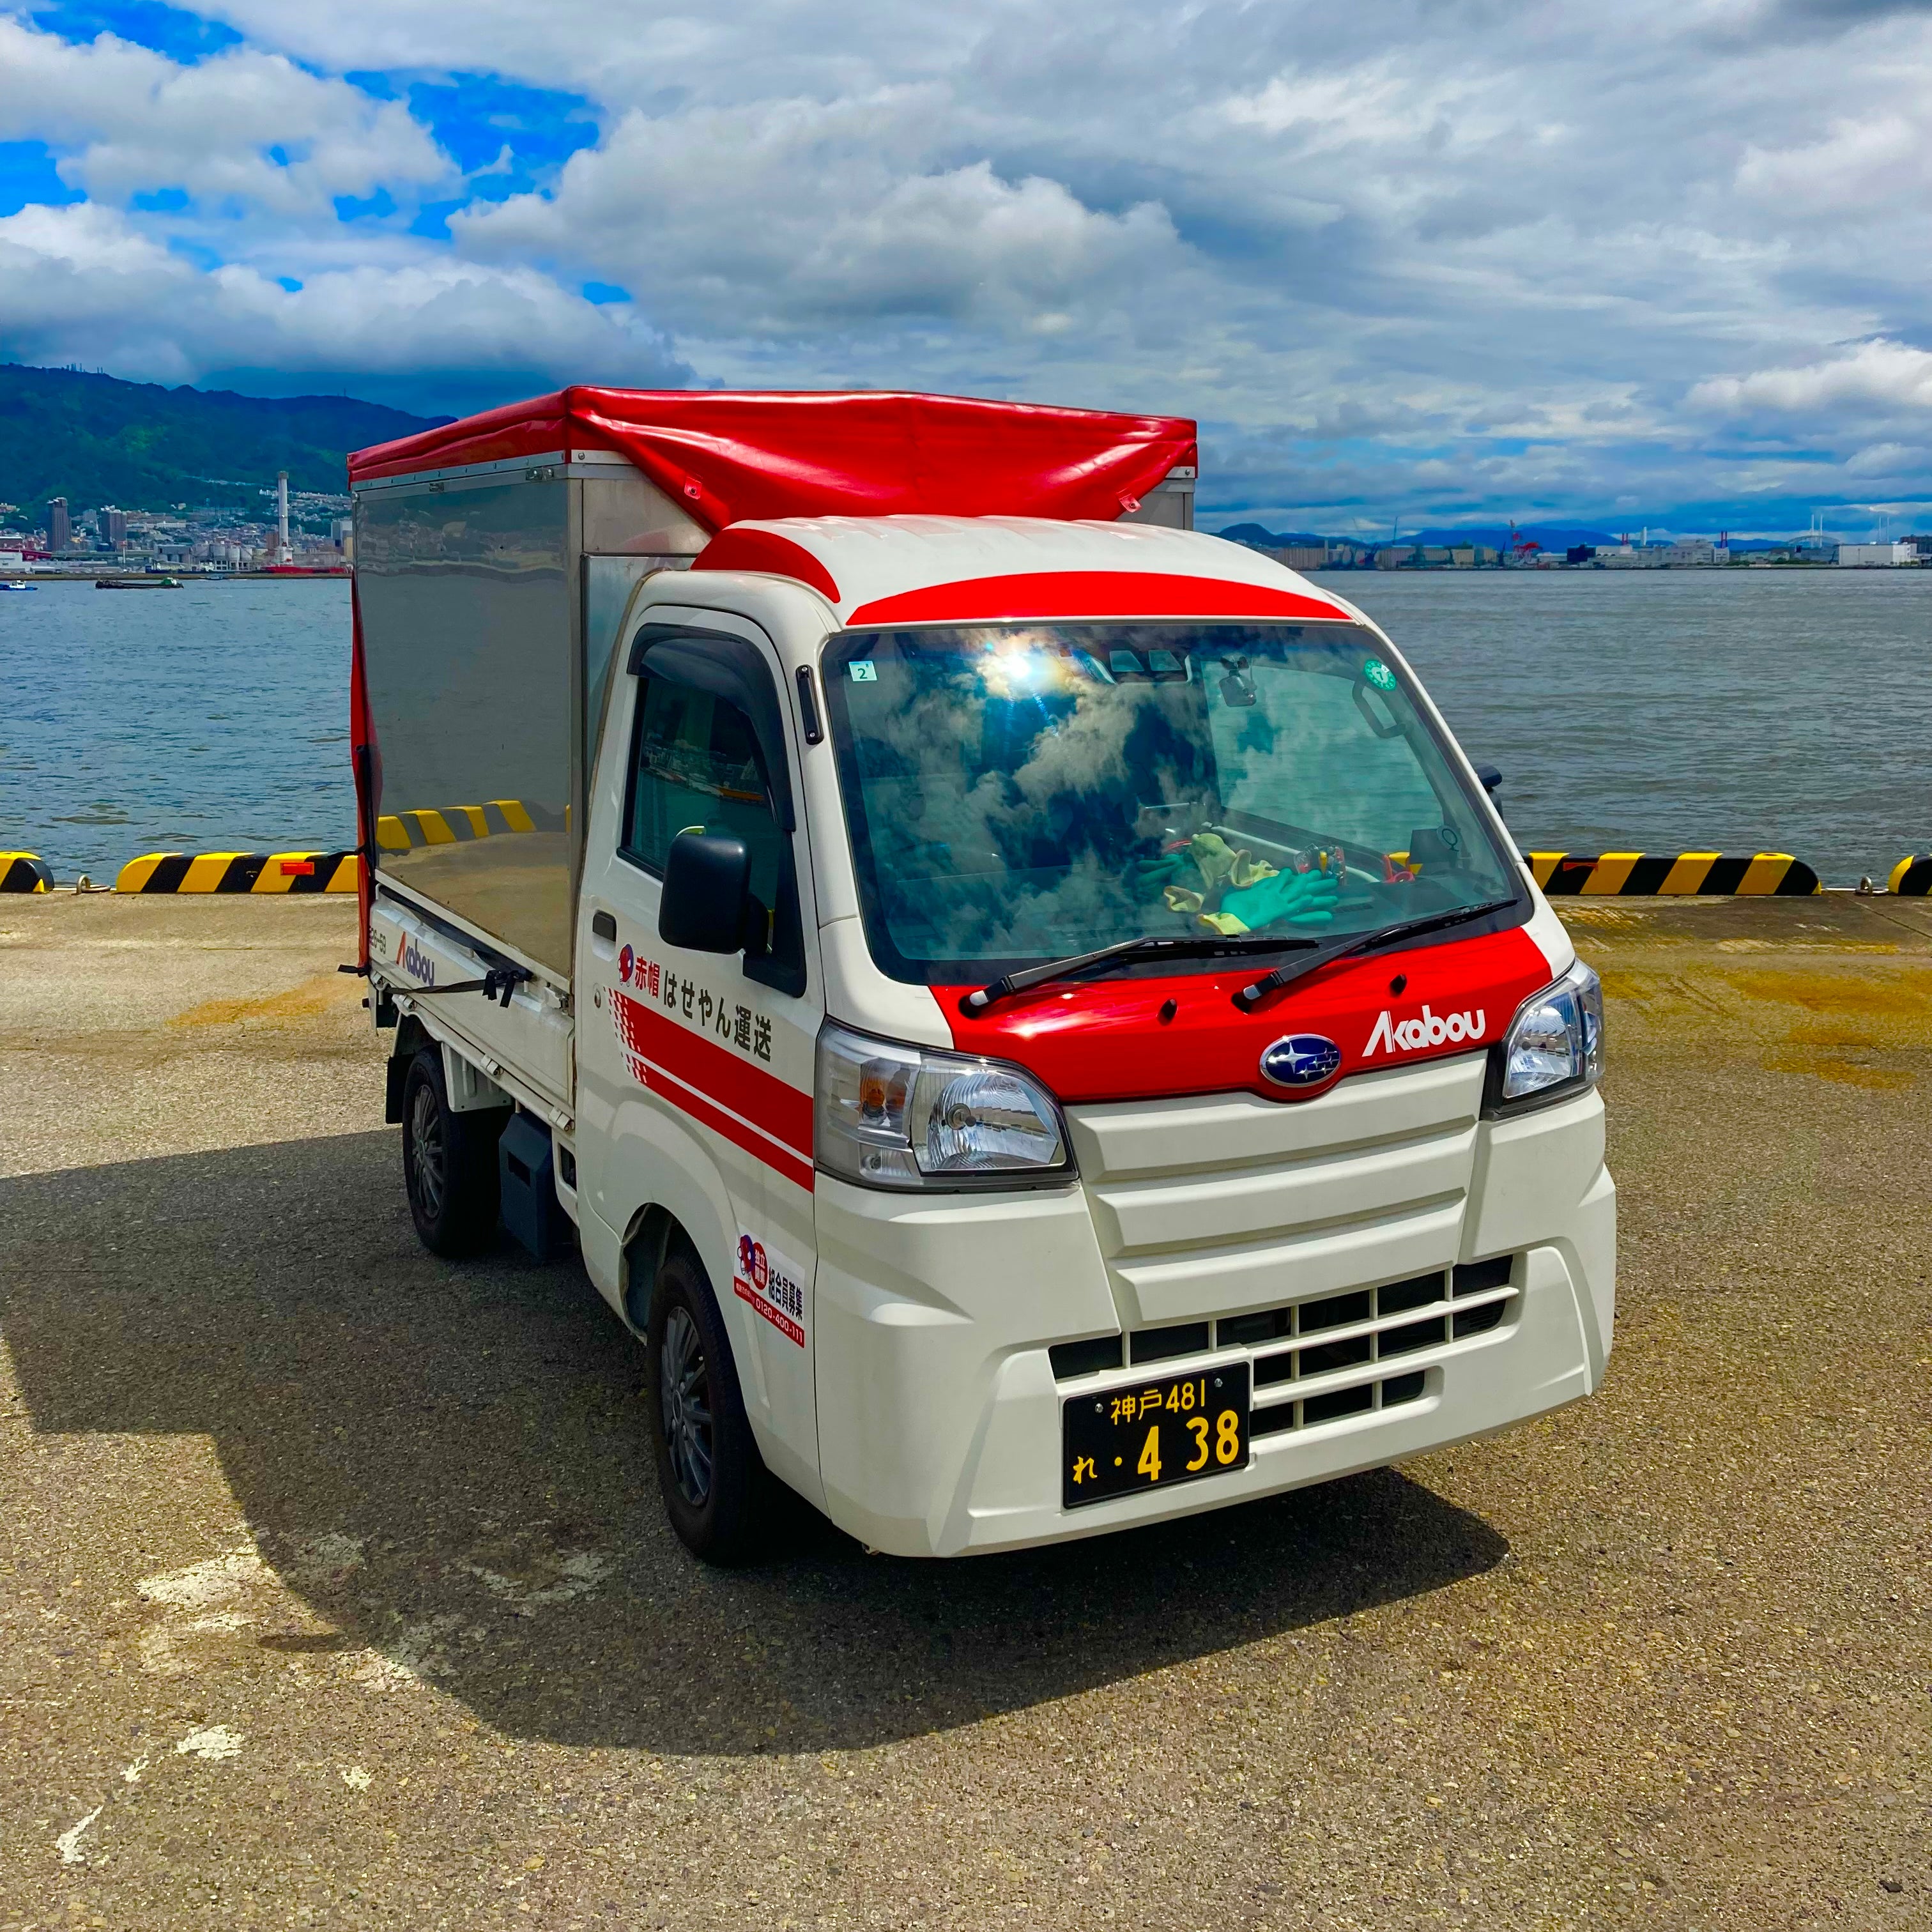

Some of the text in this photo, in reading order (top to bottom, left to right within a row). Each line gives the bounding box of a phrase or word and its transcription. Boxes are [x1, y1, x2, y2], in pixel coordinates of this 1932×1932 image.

[857, 668, 868, 679] 2
[1376, 671, 1384, 680] 7
[395, 931, 434, 986] Akabou
[634, 955, 772, 1062] 赤帽 はせやん運送
[1361, 1004, 1485, 1057] Akabou
[756, 1298, 803, 1343] 0120-400-111
[1072, 1455, 1098, 1485] れ
